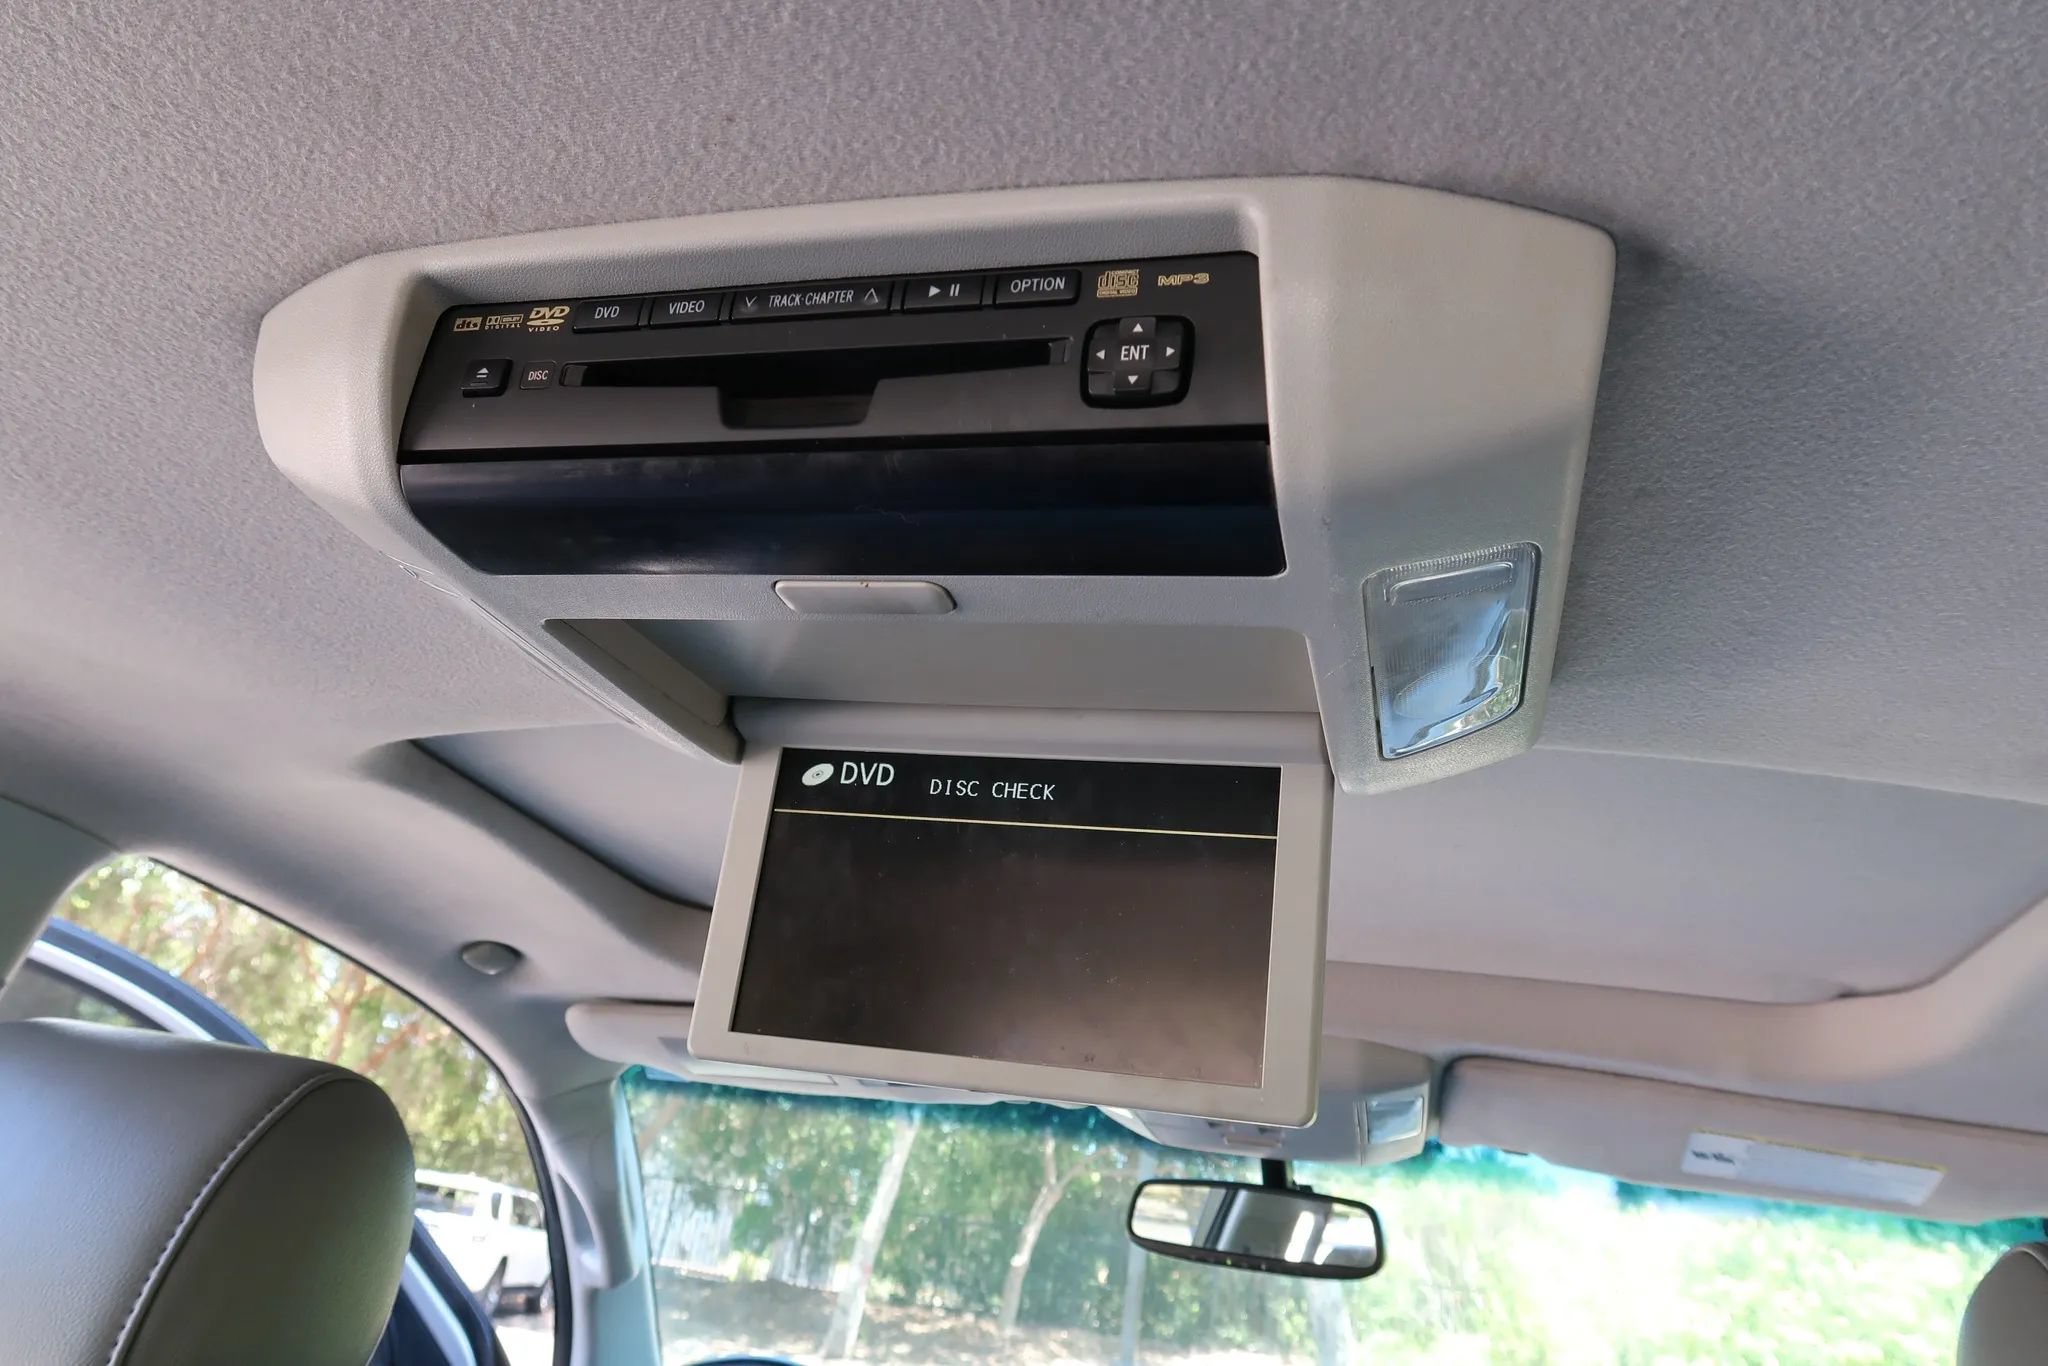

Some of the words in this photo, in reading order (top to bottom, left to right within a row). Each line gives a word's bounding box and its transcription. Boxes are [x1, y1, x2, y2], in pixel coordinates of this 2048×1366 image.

[1010, 277, 1065, 293] OPTION
[1158, 273, 1209, 286] MP3
[529, 305, 570, 319] DVD
[594, 306, 620, 319] DVD
[668, 300, 705, 315] VIDEO
[455, 318, 481, 331] dts
[1120, 345, 1149, 361] ENT
[528, 370, 549, 381] DISC
[840, 761, 895, 786] DVD
[929, 778, 980, 797] DISC
[991, 781, 1056, 801] CHECK
